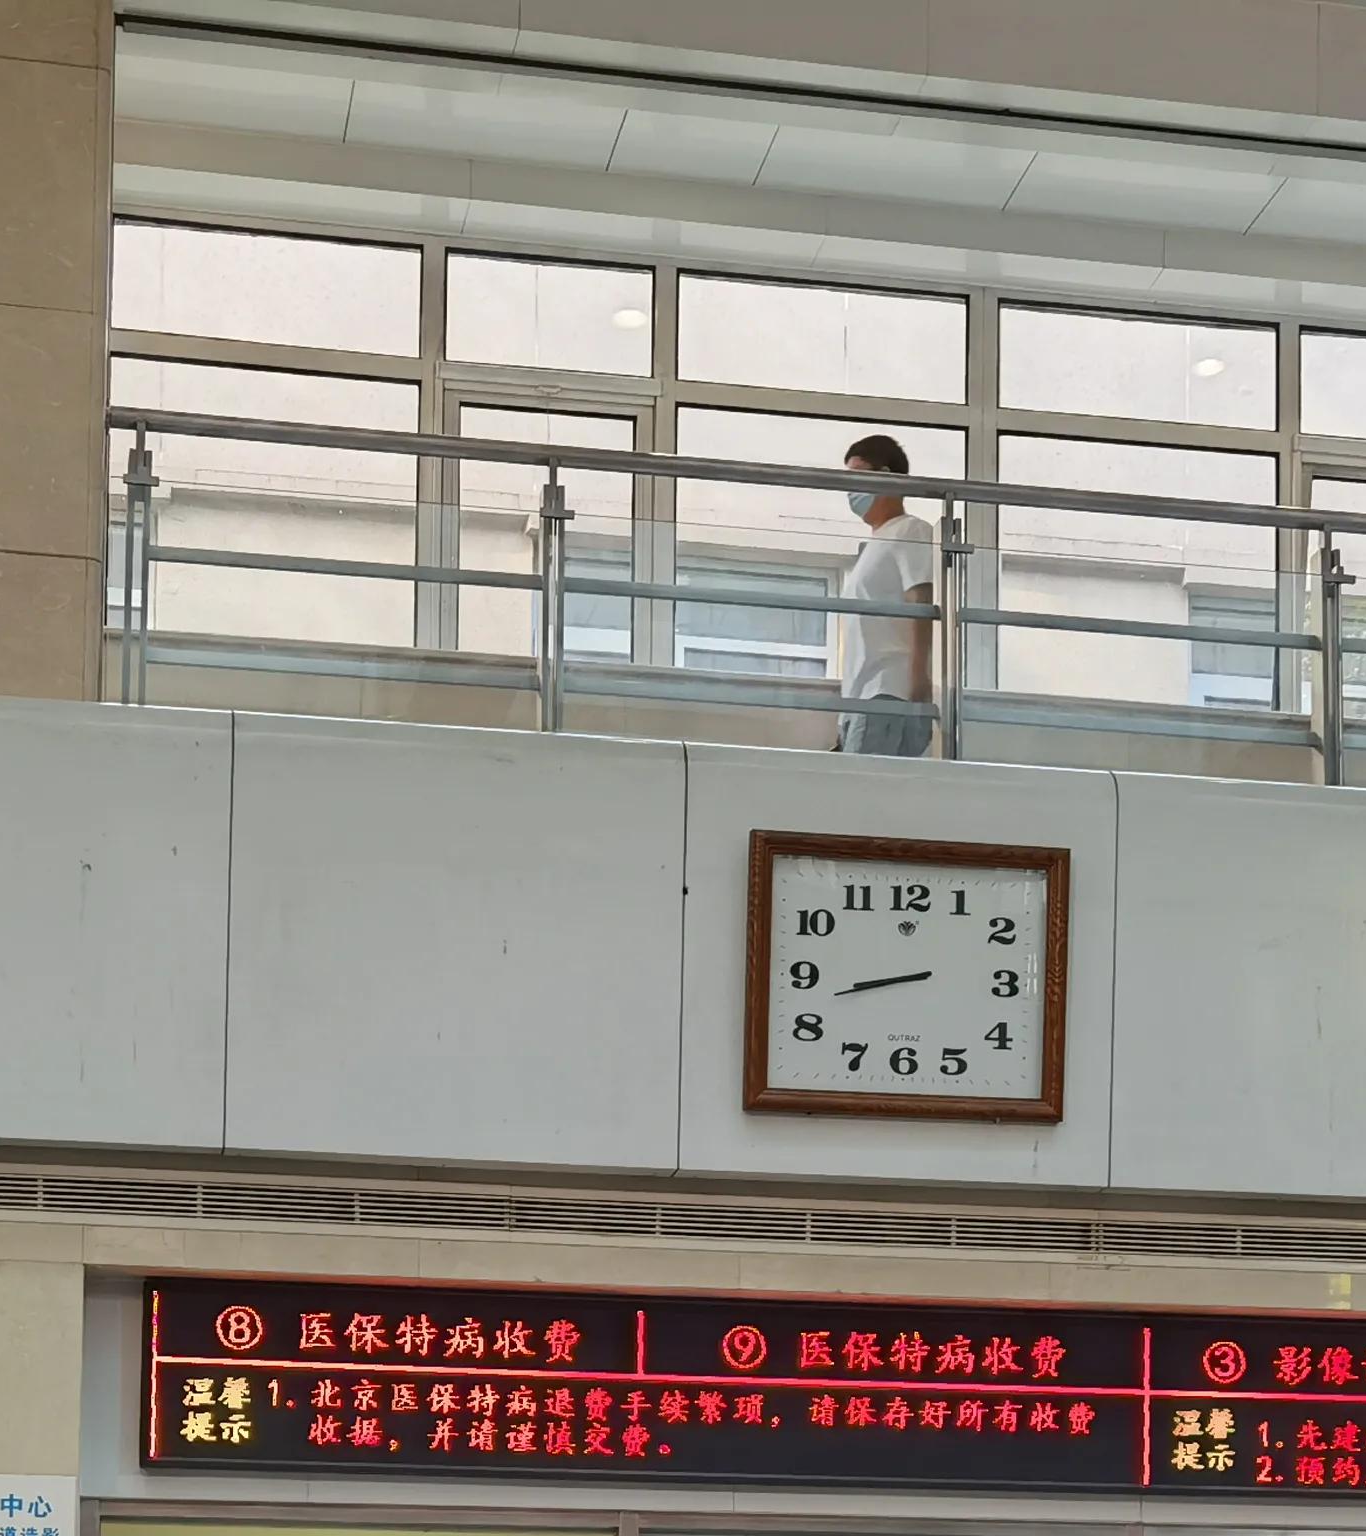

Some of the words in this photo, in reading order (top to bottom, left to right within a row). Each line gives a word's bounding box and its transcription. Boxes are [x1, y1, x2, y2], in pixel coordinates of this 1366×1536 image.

[843, 884, 875, 911] 11
[889, 884, 931, 912] 12
[949, 890, 971, 916] 1
[796, 909, 835, 936] 10
[988, 917, 1016, 945] 2
[790, 961, 819, 989] 9
[992, 970, 1019, 997] 3
[792, 1013, 824, 1041] 8
[985, 1022, 1013, 1050] 4
[841, 1042, 868, 1071] 7
[889, 1047, 918, 1075] 6
[940, 1048, 967, 1075] 5
[299, 1311, 581, 1362] 医保特病收费
[799, 1331, 1066, 1379] 医保特病收费
[183, 1378, 252, 1408] 温馨
[180, 1413, 252, 1443] 提示
[1172, 1408, 1236, 1439] 温馨
[1171, 1441, 1235, 1471] 提示
